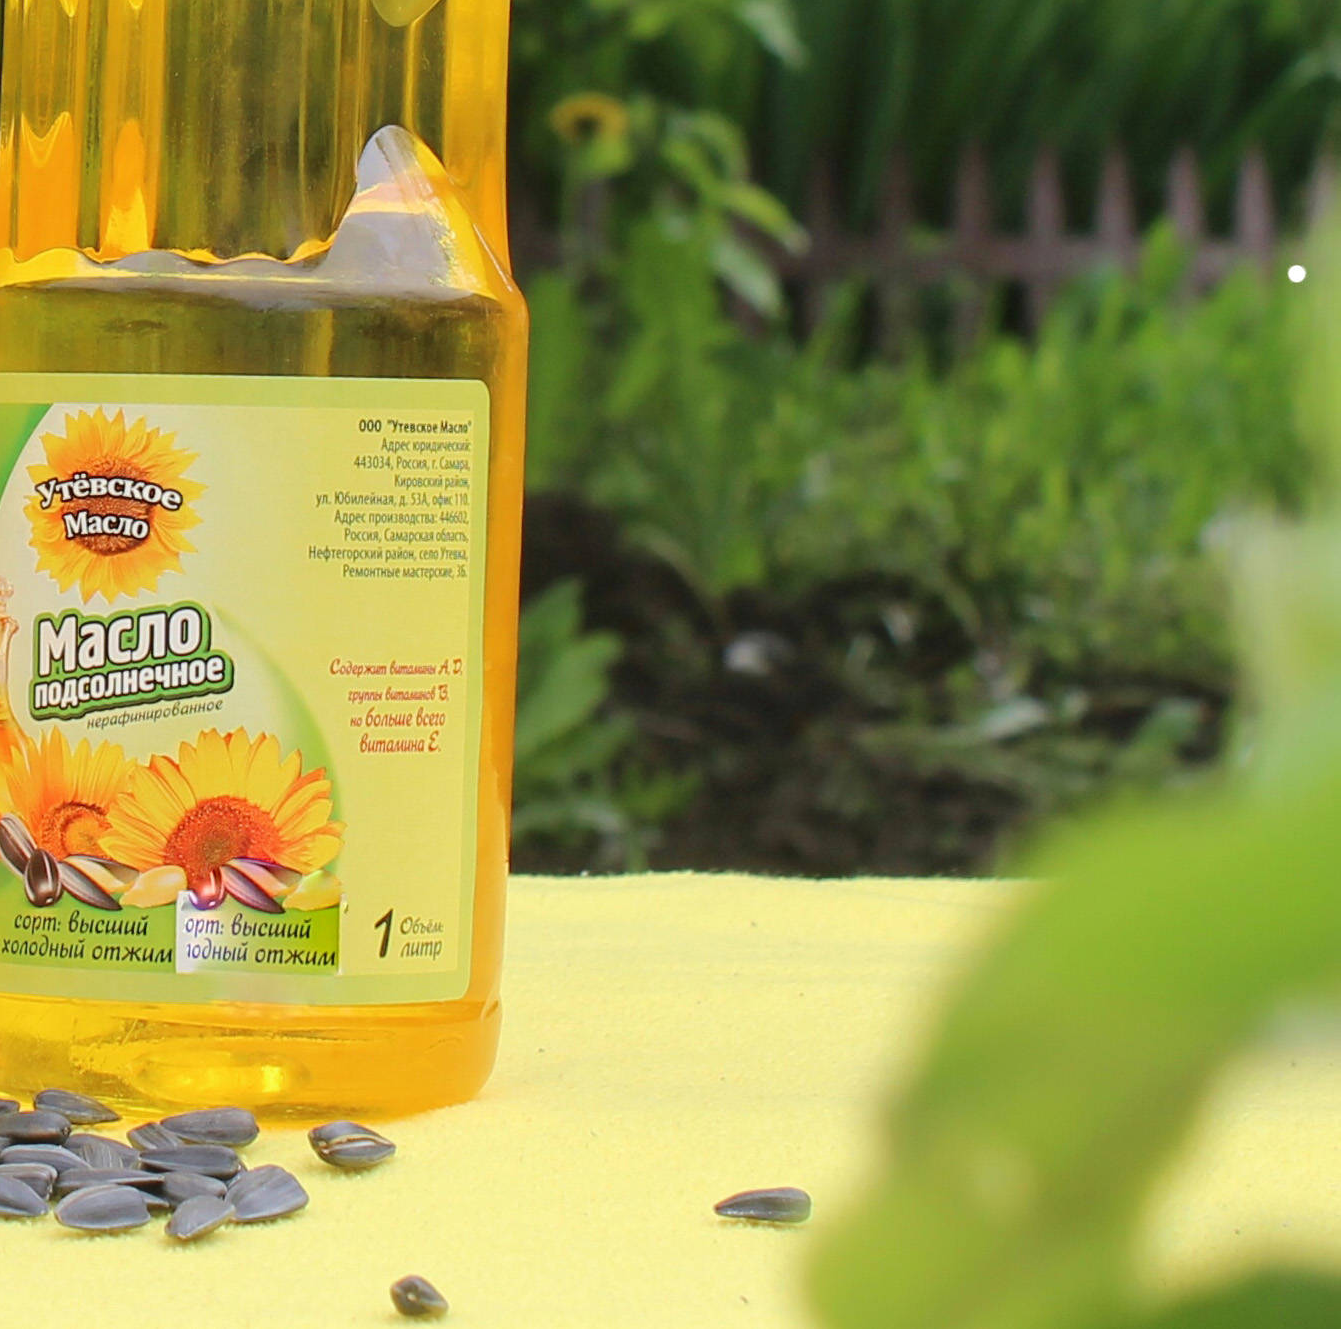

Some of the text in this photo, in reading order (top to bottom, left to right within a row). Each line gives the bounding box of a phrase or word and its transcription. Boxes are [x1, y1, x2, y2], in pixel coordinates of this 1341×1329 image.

[359, 419, 382, 433] ООО
[381, 438, 409, 453] Адрес
[354, 456, 394, 471] 443034,
[396, 457, 430, 471] Россия,
[35, 471, 183, 511] Утёвское
[394, 475, 443, 491] Кировский
[316, 495, 331, 508] ул.
[334, 491, 397, 507] Юбилейная,
[399, 496, 407, 507] д.
[432, 493, 453, 508] офис
[63, 510, 150, 540] Масло
[334, 510, 366, 526] Адрес
[369, 513, 438, 527] производства:
[344, 528, 382, 543] Россия,
[384, 528, 434, 544] Самарская
[308, 546, 383, 563] Нефтегорский
[385, 547, 417, 563] район,
[419, 550, 439, 561] село
[343, 564, 400, 579] Ремонтные
[38, 607, 201, 677] Масло
[329, 657, 387, 676] Содержит
[34, 655, 225, 710] подсолнечное
[87, 699, 223, 730] нерафинированное
[350, 706, 446, 728] но больше всего
[360, 732, 425, 753] витамина
[14, 910, 149, 936] сорт: высший
[231, 913, 312, 939] высший
[375, 908, 393, 958] 1
[2, 935, 173, 963] холодный отжим
[255, 948, 336, 967] отжим
[400, 940, 442, 961] литр
